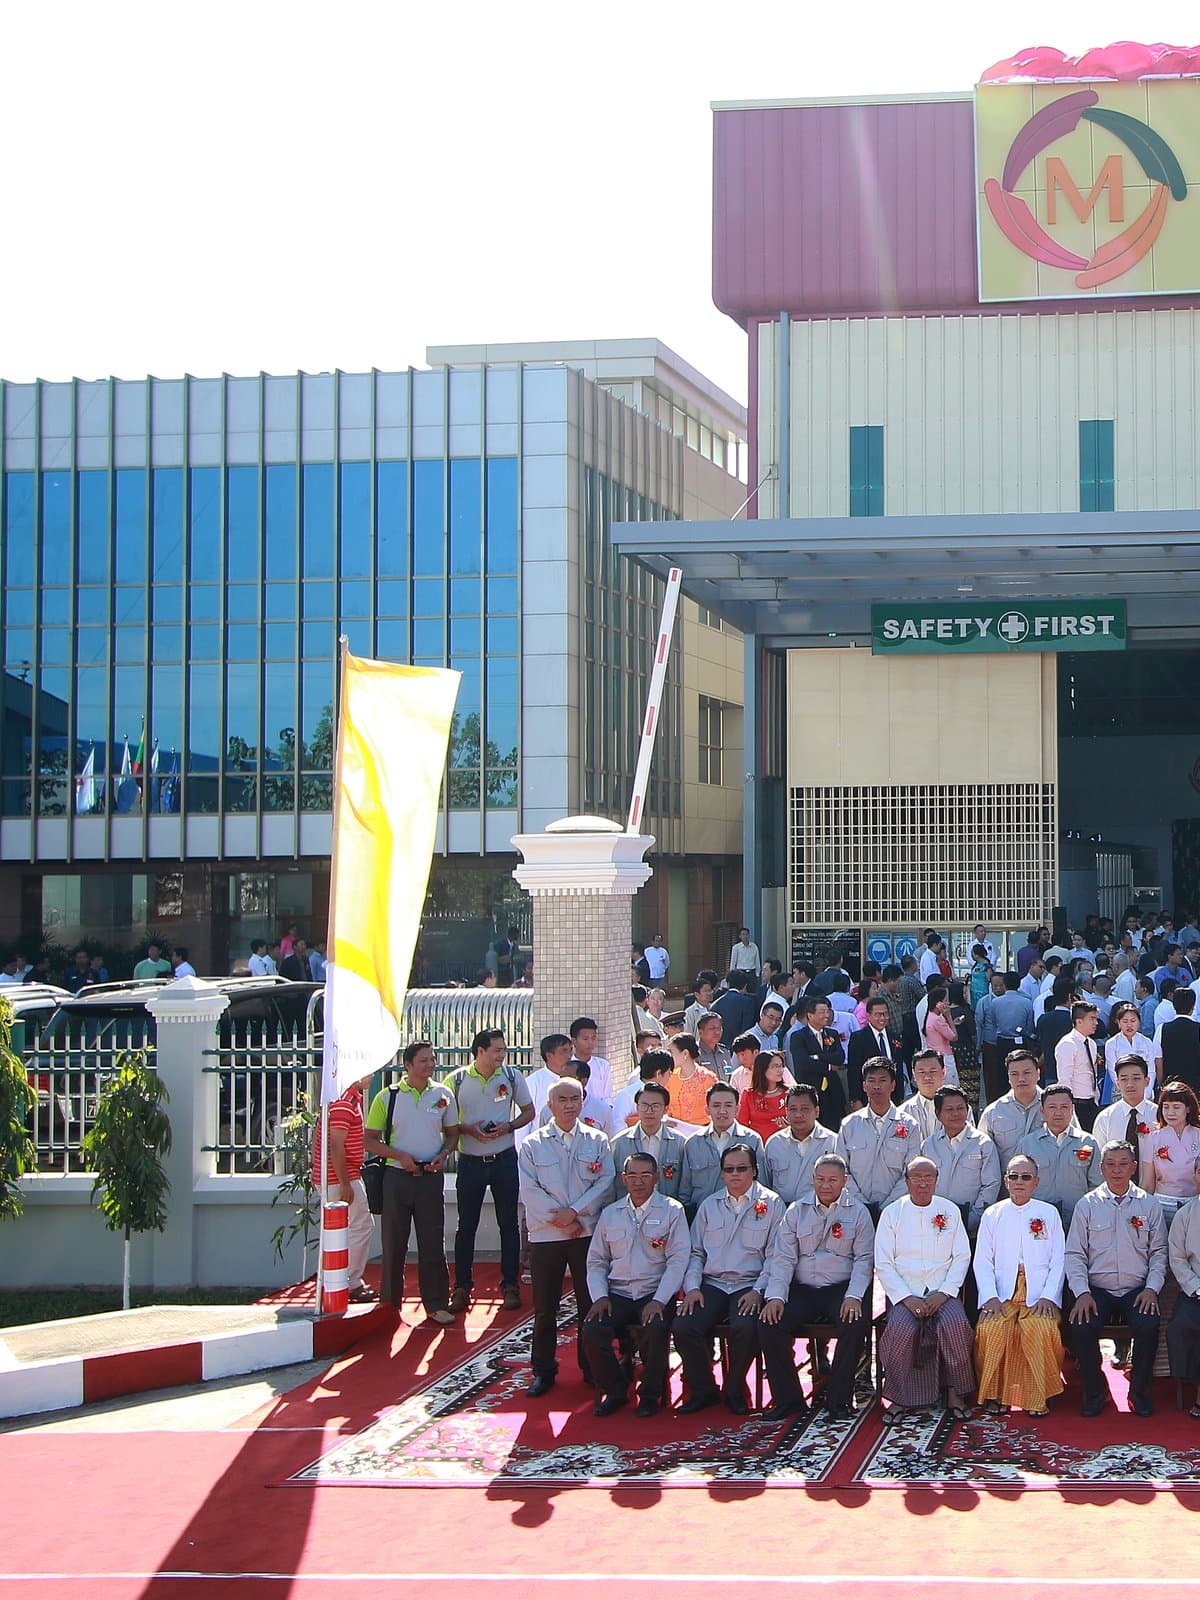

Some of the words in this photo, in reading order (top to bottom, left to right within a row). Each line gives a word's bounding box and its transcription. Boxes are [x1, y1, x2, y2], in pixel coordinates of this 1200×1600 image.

[1045, 154, 1125, 227] M
[883, 617, 994, 639] SAFETY
[1034, 615, 1115, 636] FIRST
